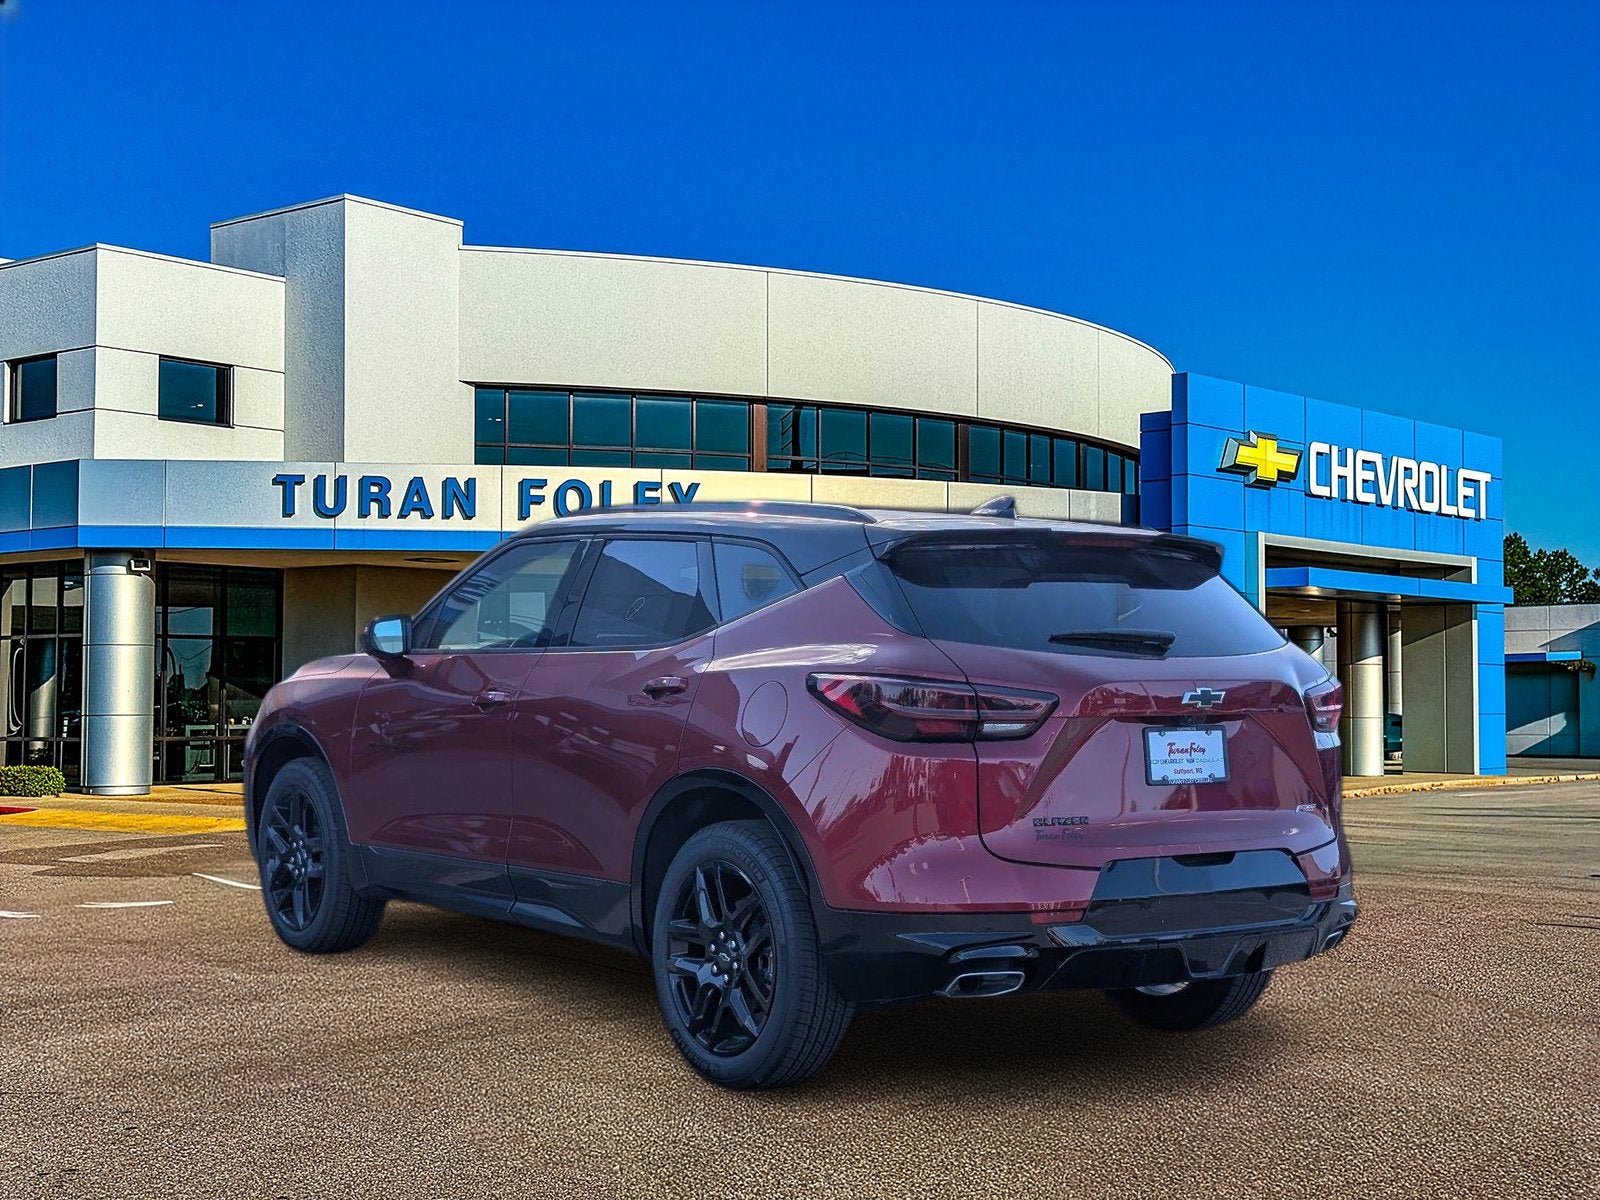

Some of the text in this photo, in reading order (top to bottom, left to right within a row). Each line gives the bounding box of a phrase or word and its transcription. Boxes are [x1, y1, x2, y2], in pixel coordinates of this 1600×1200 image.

[272, 473, 477, 520] TURAN
[1307, 441, 1492, 520] CHEVROLET
[1032, 815, 1090, 827] BLAZER
